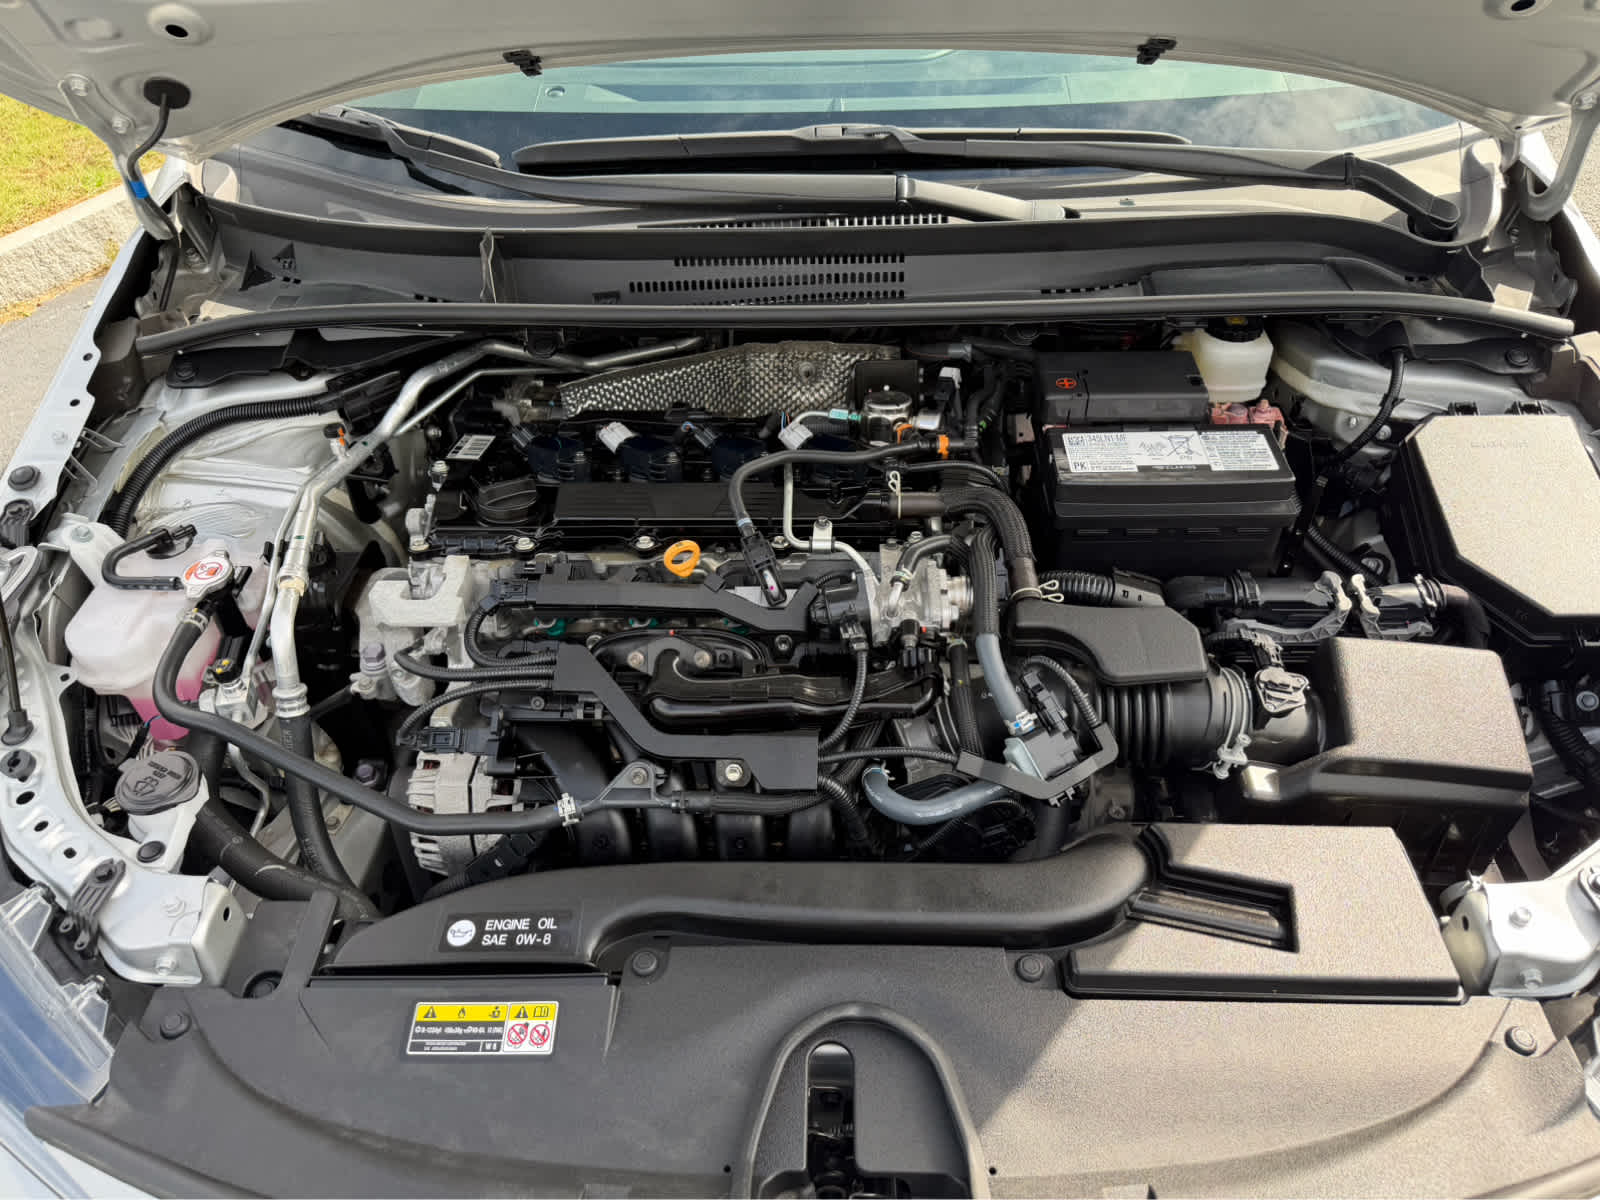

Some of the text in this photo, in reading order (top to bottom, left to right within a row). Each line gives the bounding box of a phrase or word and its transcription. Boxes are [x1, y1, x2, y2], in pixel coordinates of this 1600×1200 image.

[1073, 461, 1087, 471] PK
[484, 917, 557, 931] ENGINE OIL
[481, 933, 551, 946] SAE 0W-8
